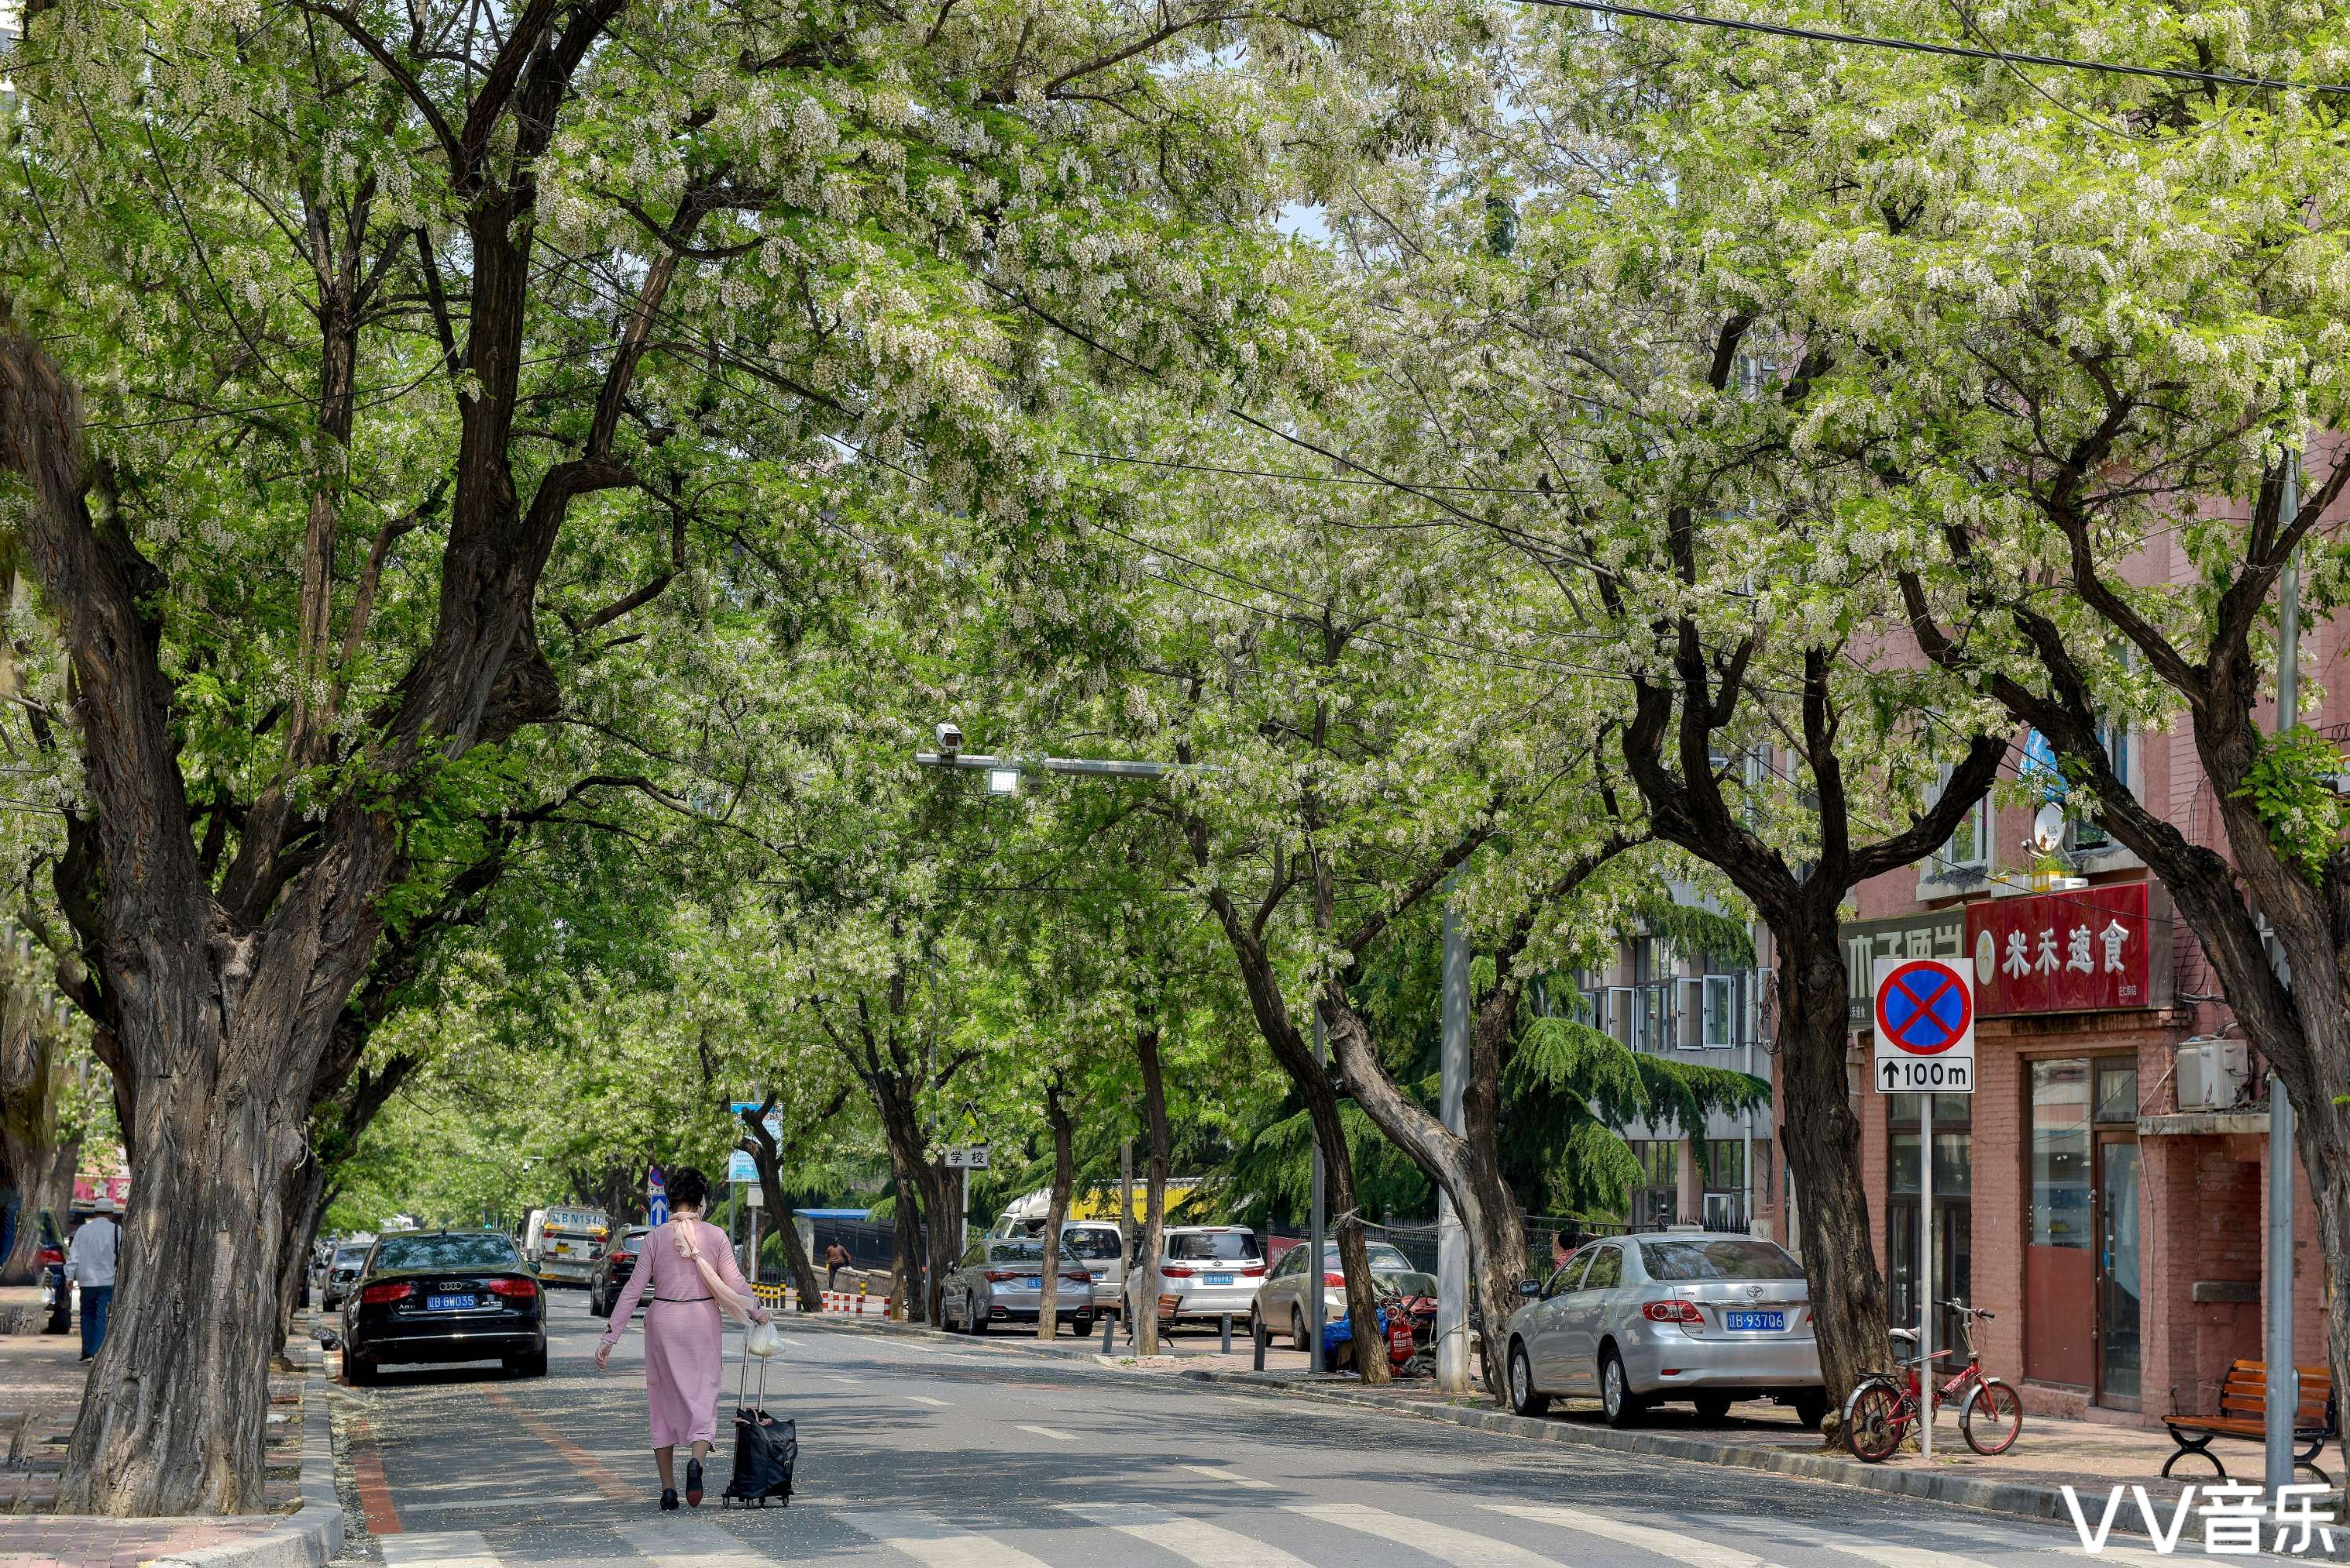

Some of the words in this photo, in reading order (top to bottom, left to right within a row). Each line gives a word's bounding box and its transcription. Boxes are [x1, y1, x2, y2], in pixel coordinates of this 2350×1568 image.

[2002, 918, 2129, 979] 米禾速食
[1905, 1062, 1967, 1086] 100m
[950, 1150, 984, 1164] 学校
